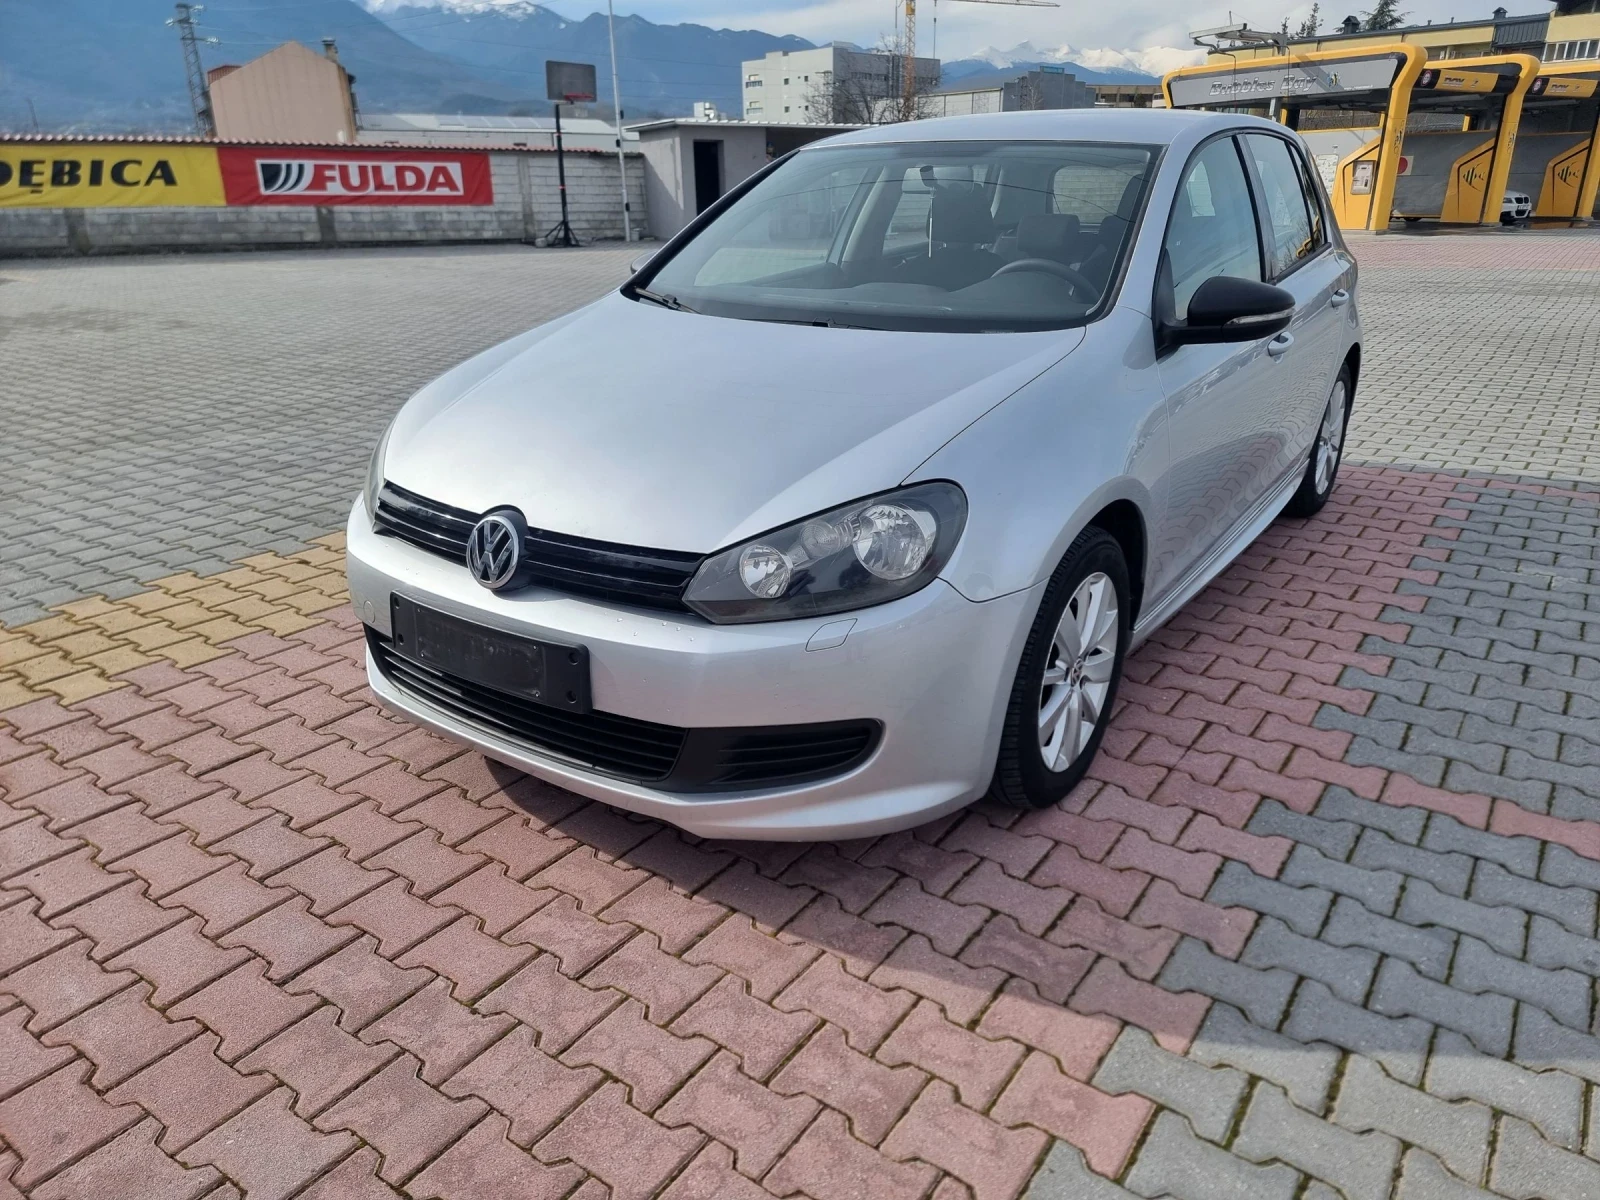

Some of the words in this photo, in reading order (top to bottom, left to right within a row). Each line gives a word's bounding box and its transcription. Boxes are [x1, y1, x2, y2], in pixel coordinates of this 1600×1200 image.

[1209, 77, 1275, 96] Bubbles
[1280, 74, 1318, 91] Bay
[304, 163, 461, 194] FULDA
[468, 517, 517, 586] VW
